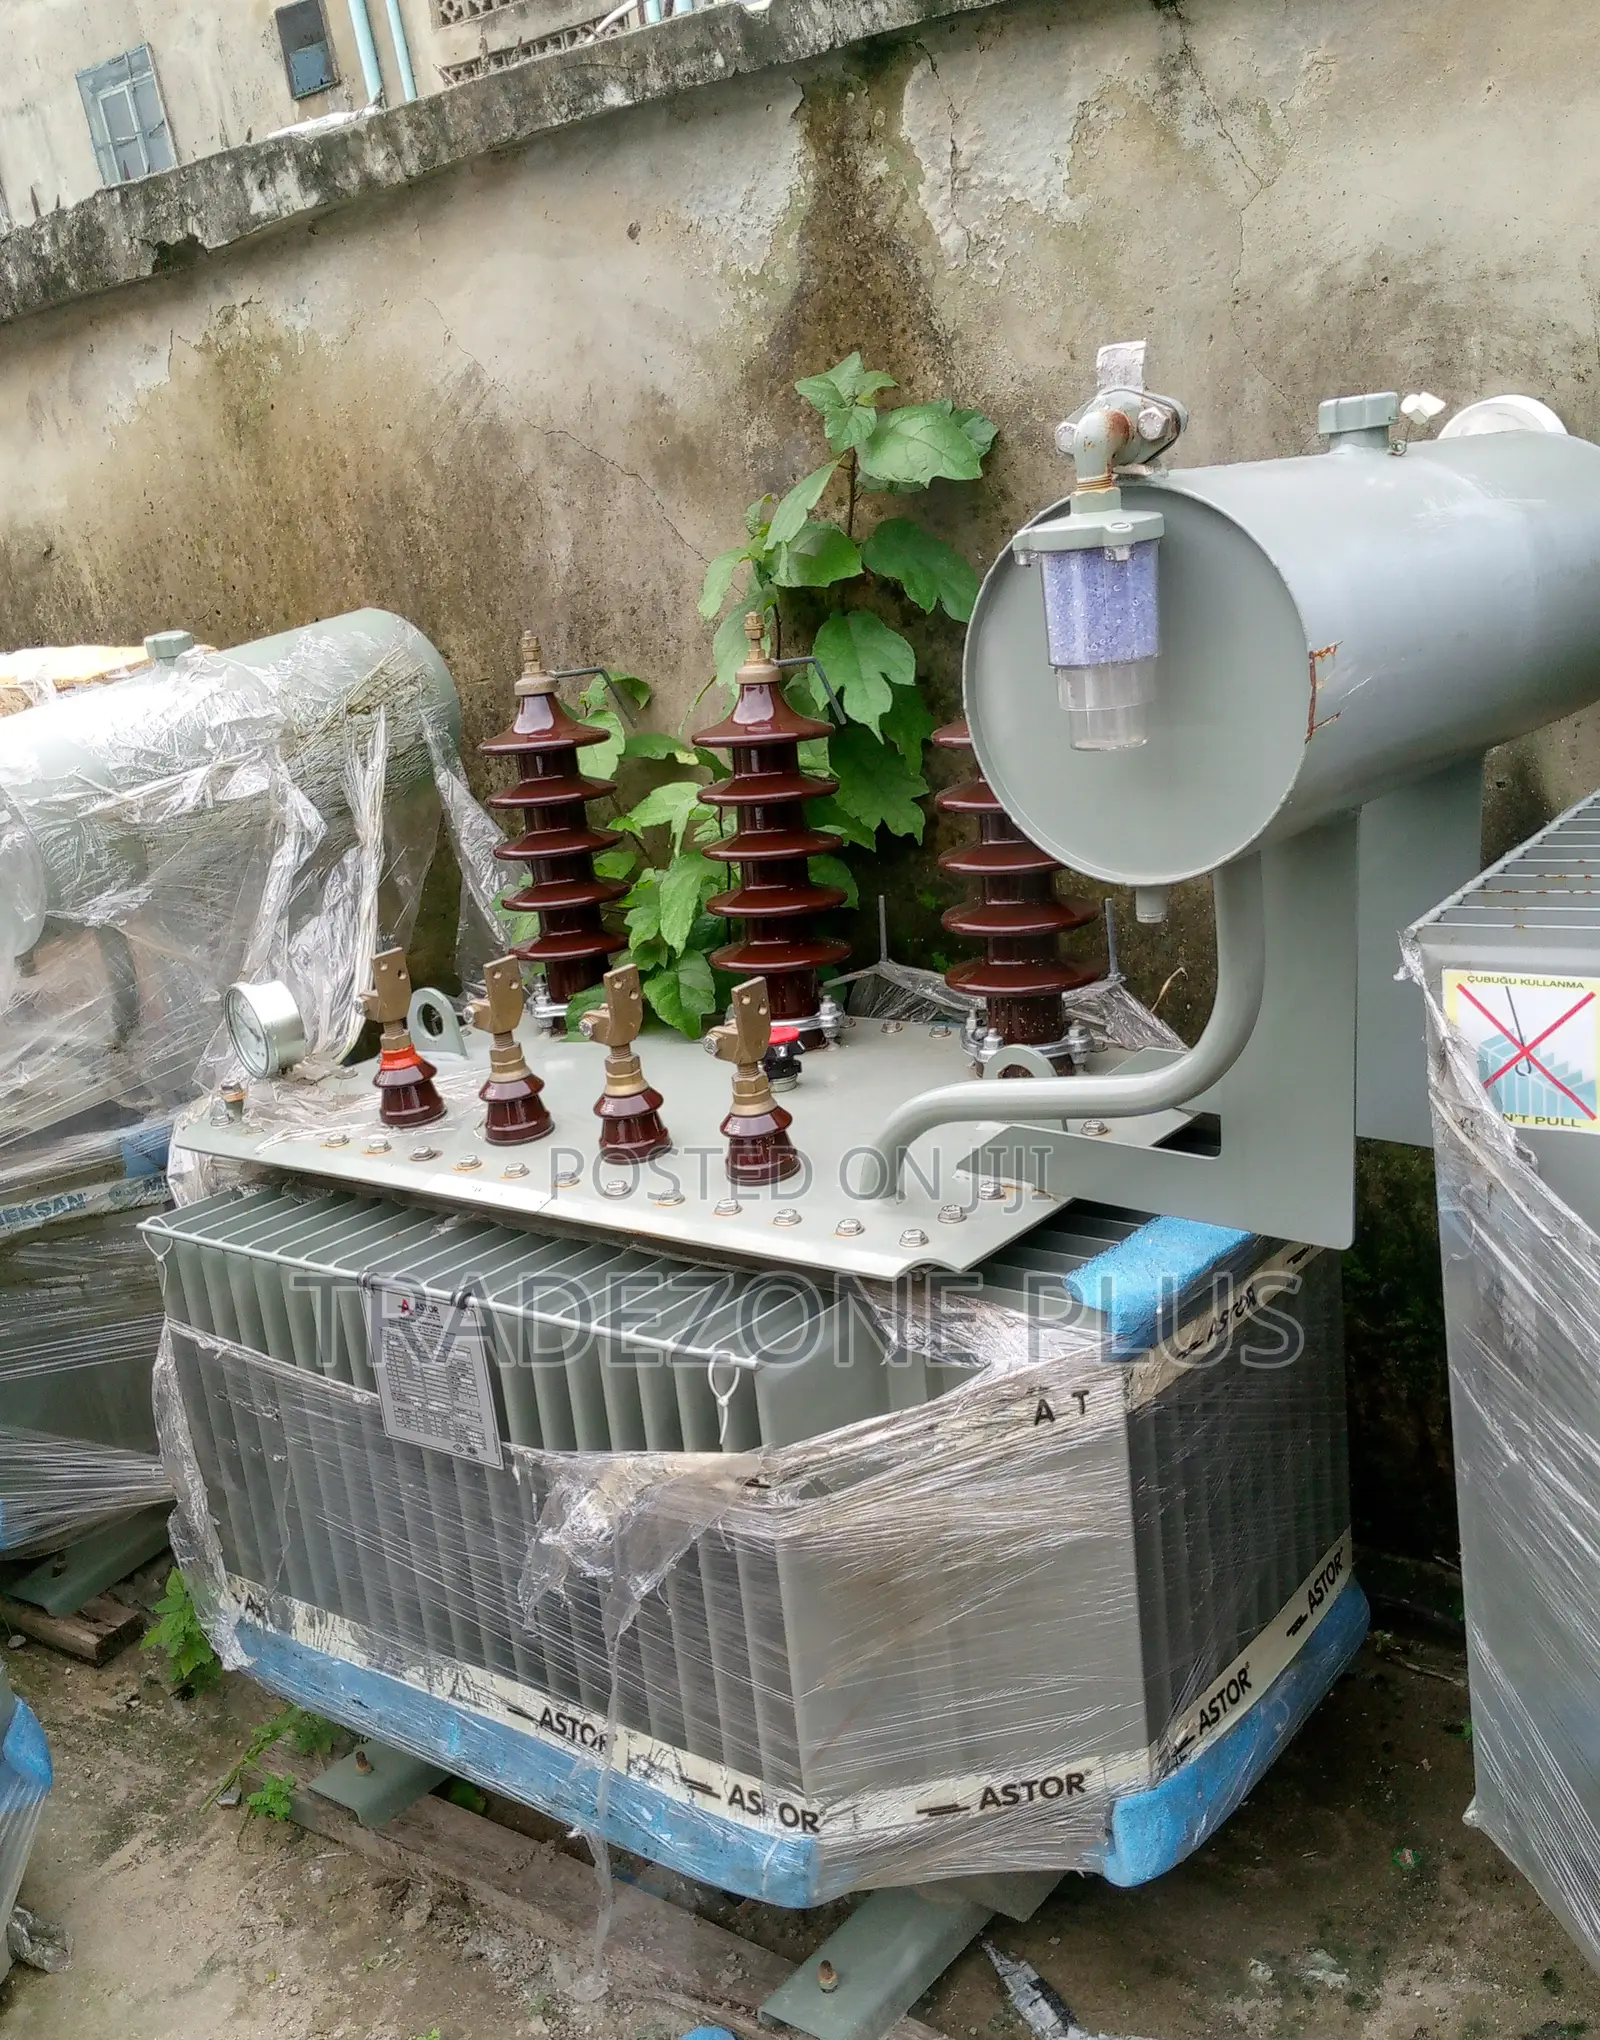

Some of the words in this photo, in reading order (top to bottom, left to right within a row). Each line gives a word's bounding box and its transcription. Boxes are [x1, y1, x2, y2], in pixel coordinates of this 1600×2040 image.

[1467, 975, 1517, 986] ÇUBUĞU
[1520, 978, 1584, 989] KULLANMA
[778, 1046, 786, 1057] 2
[1535, 1116, 1582, 1128] PULL
[1307, 1552, 1344, 1615] ASTOR
[1199, 1667, 1252, 1734] ASTOR
[728, 1784, 821, 1834] ASOR
[980, 1772, 1088, 1810] ASTOR
